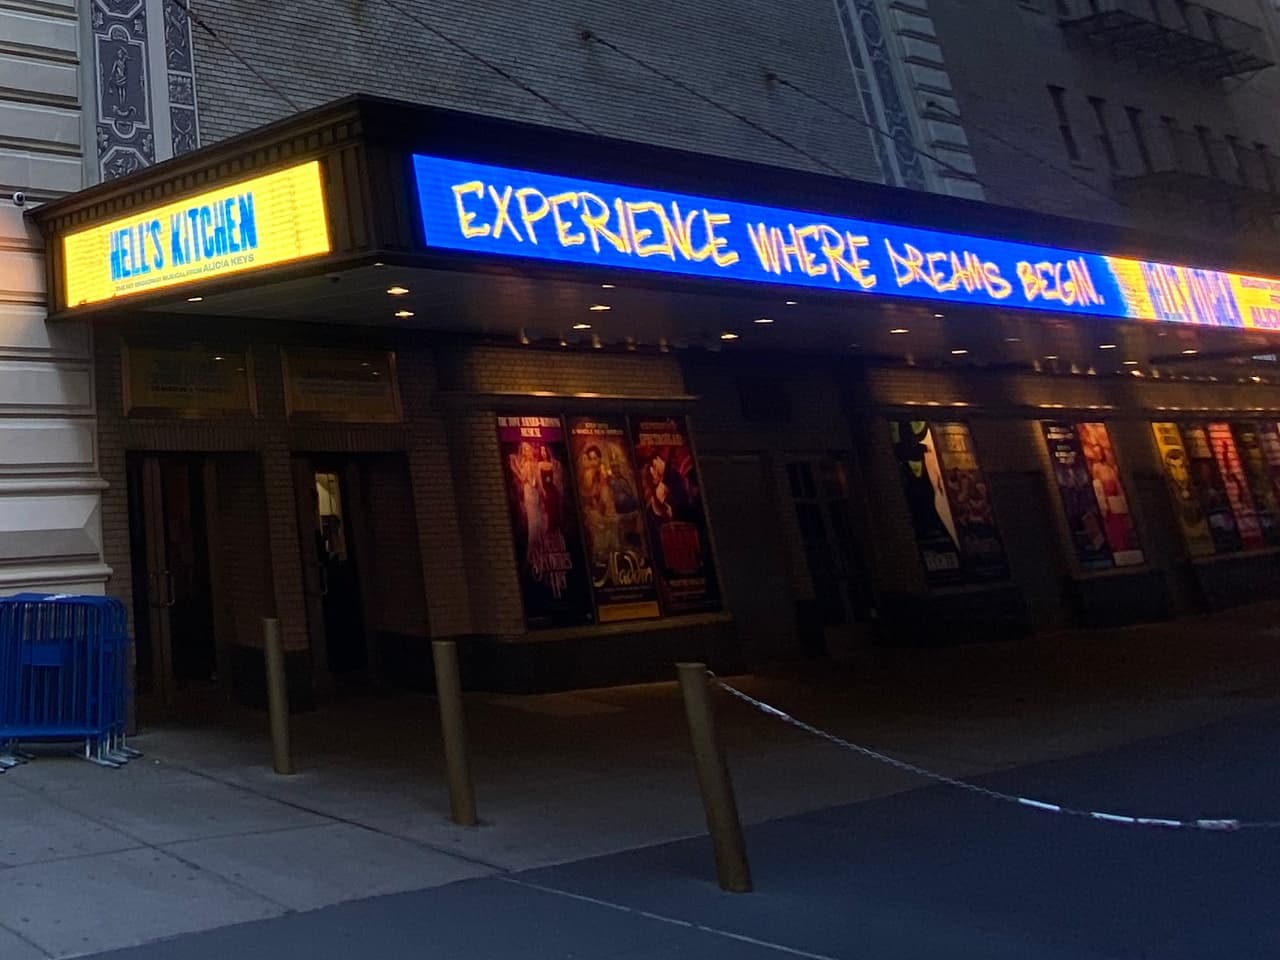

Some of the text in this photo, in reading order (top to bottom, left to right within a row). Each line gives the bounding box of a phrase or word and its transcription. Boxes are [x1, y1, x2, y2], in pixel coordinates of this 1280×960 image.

[109, 191, 258, 281] HELL'S KITCHEN
[203, 261, 229, 274] ALICIA
[231, 254, 254, 267] KEYS
[454, 182, 737, 267] EXPERIENCE
[748, 222, 876, 289] WHERE
[884, 238, 1012, 300] DREAMS
[1016, 261, 1104, 307] BEGIN.
